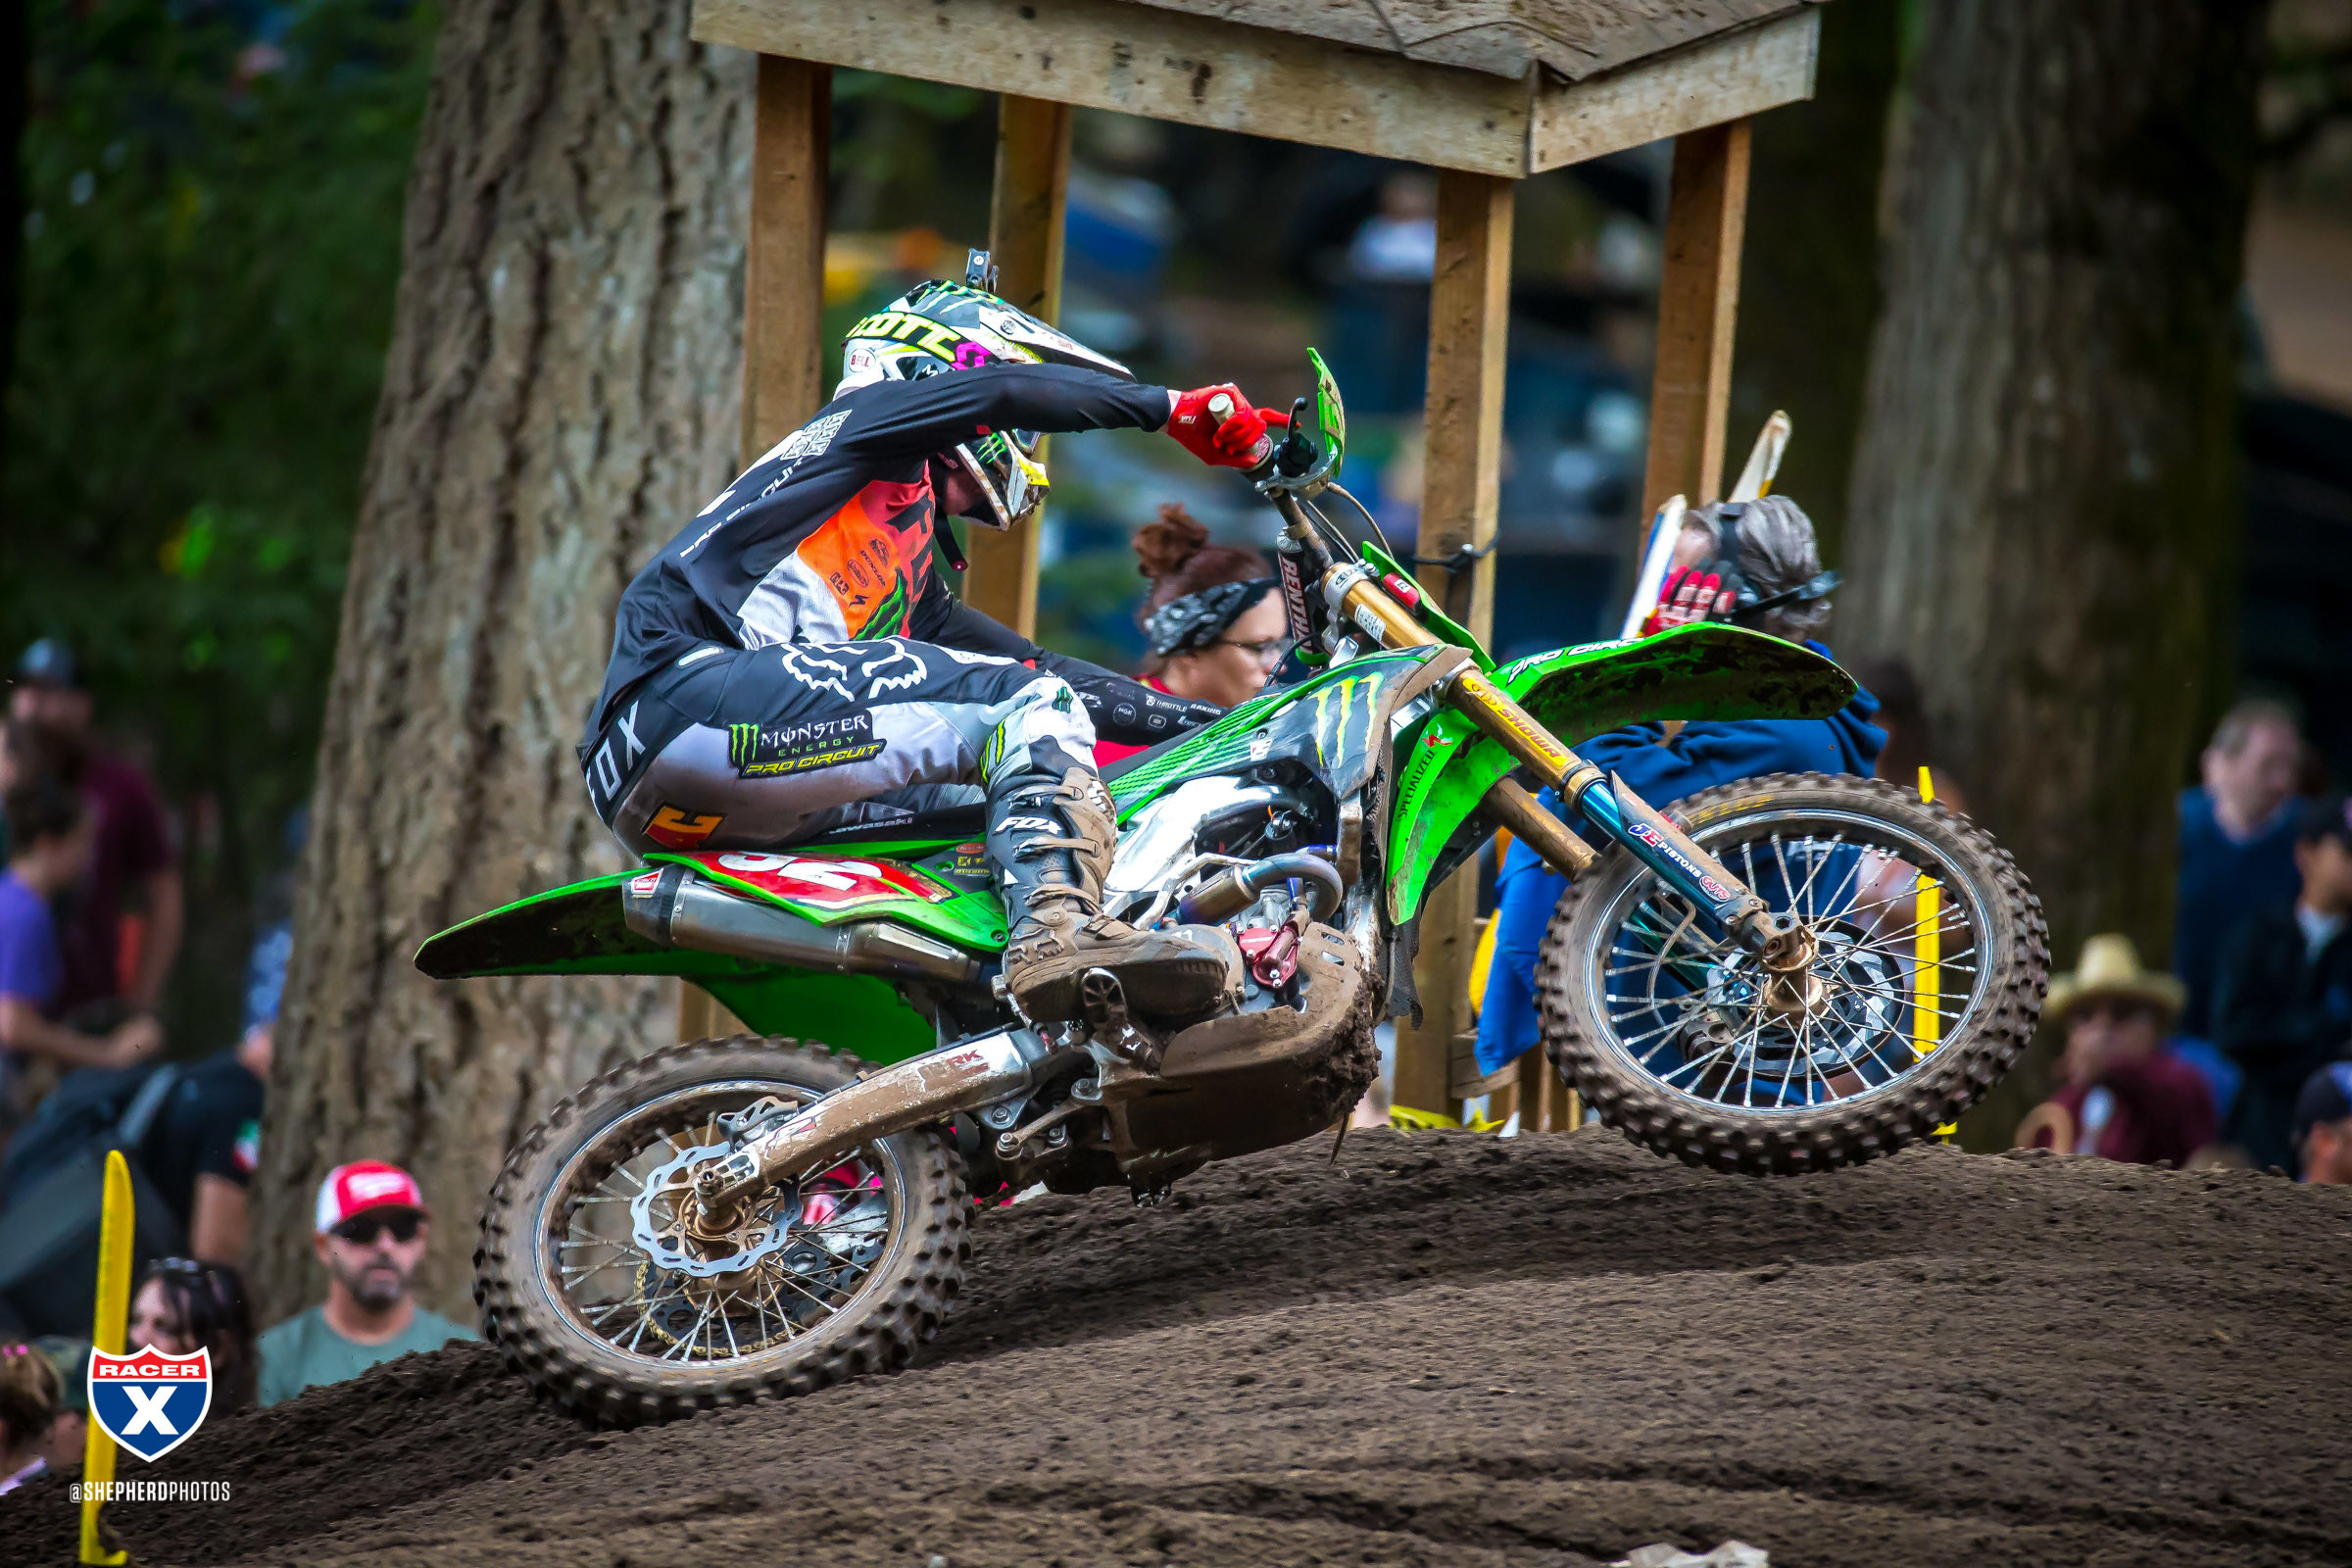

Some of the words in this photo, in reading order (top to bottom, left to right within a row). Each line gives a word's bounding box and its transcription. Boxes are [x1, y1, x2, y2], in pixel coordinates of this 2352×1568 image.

[851, 355, 869, 368] BELL
[860, 550, 886, 587] DUNLOP
[1155, 700, 1188, 713] THROTTLE
[760, 714, 869, 748] MONSTER
[1499, 708, 1562, 759] SHOWA
[587, 700, 647, 802] OX
[745, 760, 795, 776] PRO
[797, 743, 883, 769] CIRCUIT
[778, 736, 855, 757] ENERGY
[1398, 750, 1434, 819] SPECIALIZED
[828, 817, 913, 835] awasaki
[995, 816, 1061, 835] FOX
[1628, 822, 1665, 848] JE
[1657, 840, 1703, 878] PISTONS
[1701, 875, 1732, 900] GUTS
[945, 1050, 984, 1066] RK
